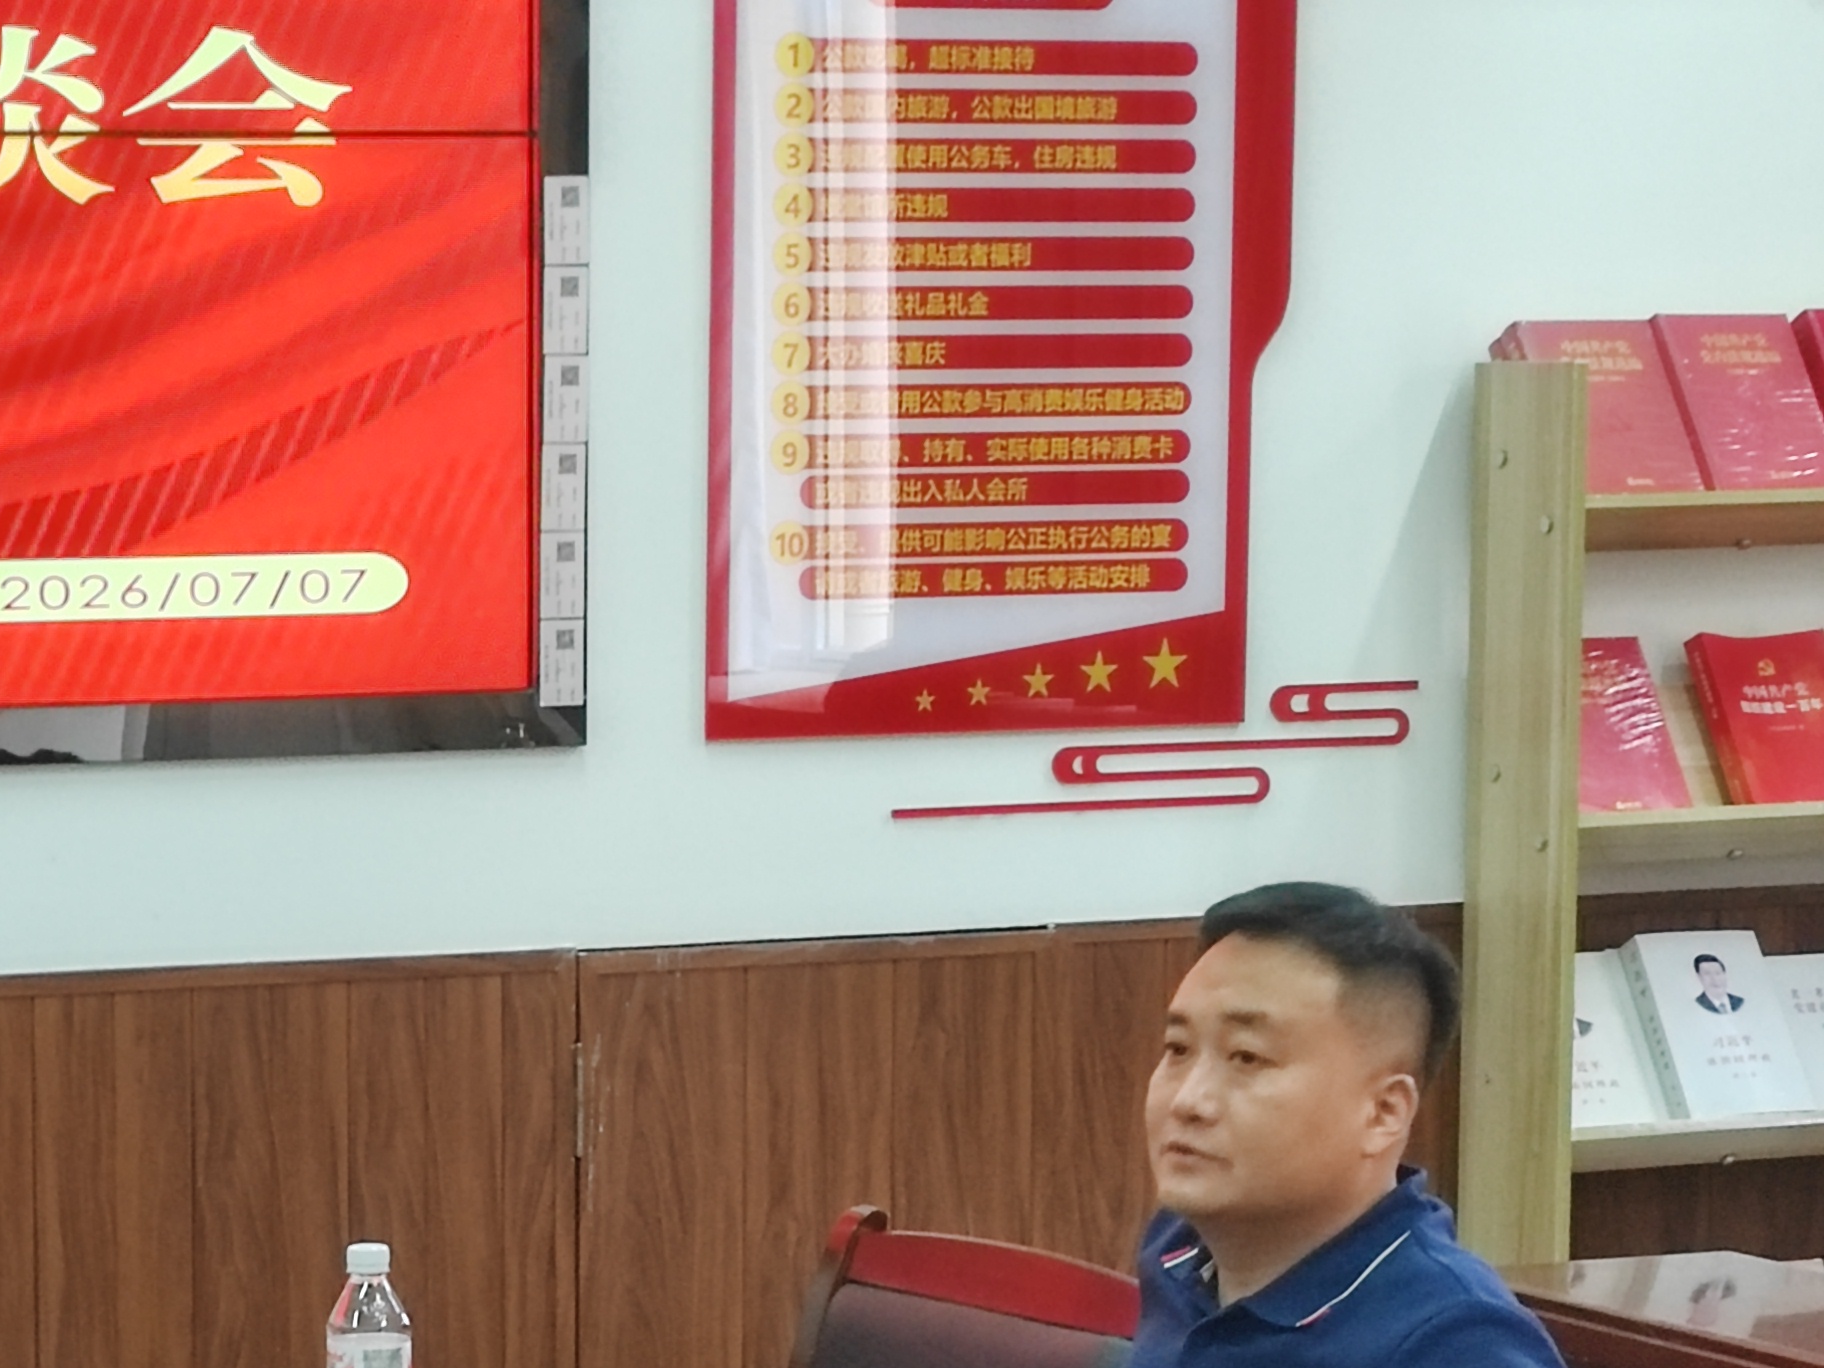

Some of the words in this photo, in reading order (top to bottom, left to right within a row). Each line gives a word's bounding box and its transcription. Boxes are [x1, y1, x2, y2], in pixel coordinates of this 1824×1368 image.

[787, 42, 800, 68] 1
[786, 93, 802, 119] 2
[786, 143, 801, 169] 3
[784, 193, 802, 219] 4
[785, 243, 800, 268] 5
[784, 292, 799, 318] 6
[783, 342, 798, 368] 7
[782, 392, 798, 418] 8
[781, 441, 798, 467] 9
[774, 531, 804, 558] 10
